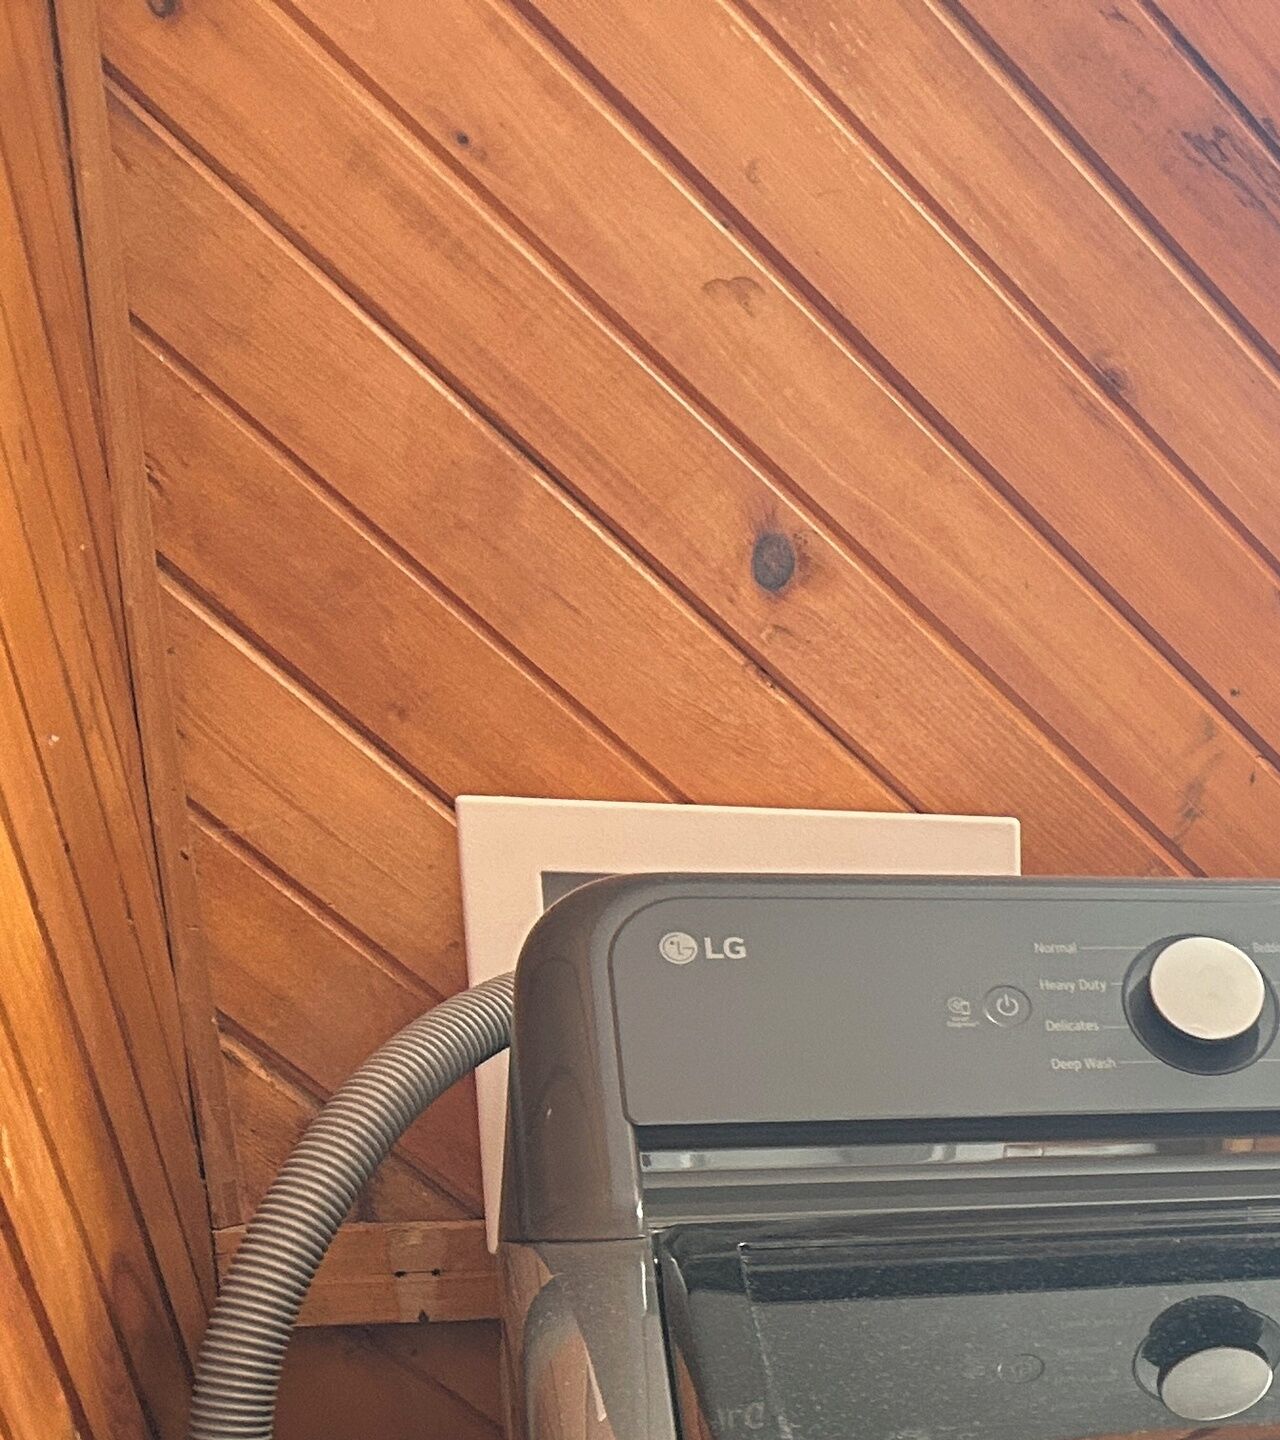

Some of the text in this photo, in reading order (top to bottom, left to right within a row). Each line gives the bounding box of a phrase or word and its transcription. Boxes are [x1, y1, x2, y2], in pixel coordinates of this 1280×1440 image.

[704, 936, 747, 959] LG
[1034, 942, 1077, 954] Normal
[1039, 979, 1107, 993] Heavy Duty
[1045, 1019, 1099, 1032] Delicates
[1051, 1056, 1117, 1071] Deep Wash
